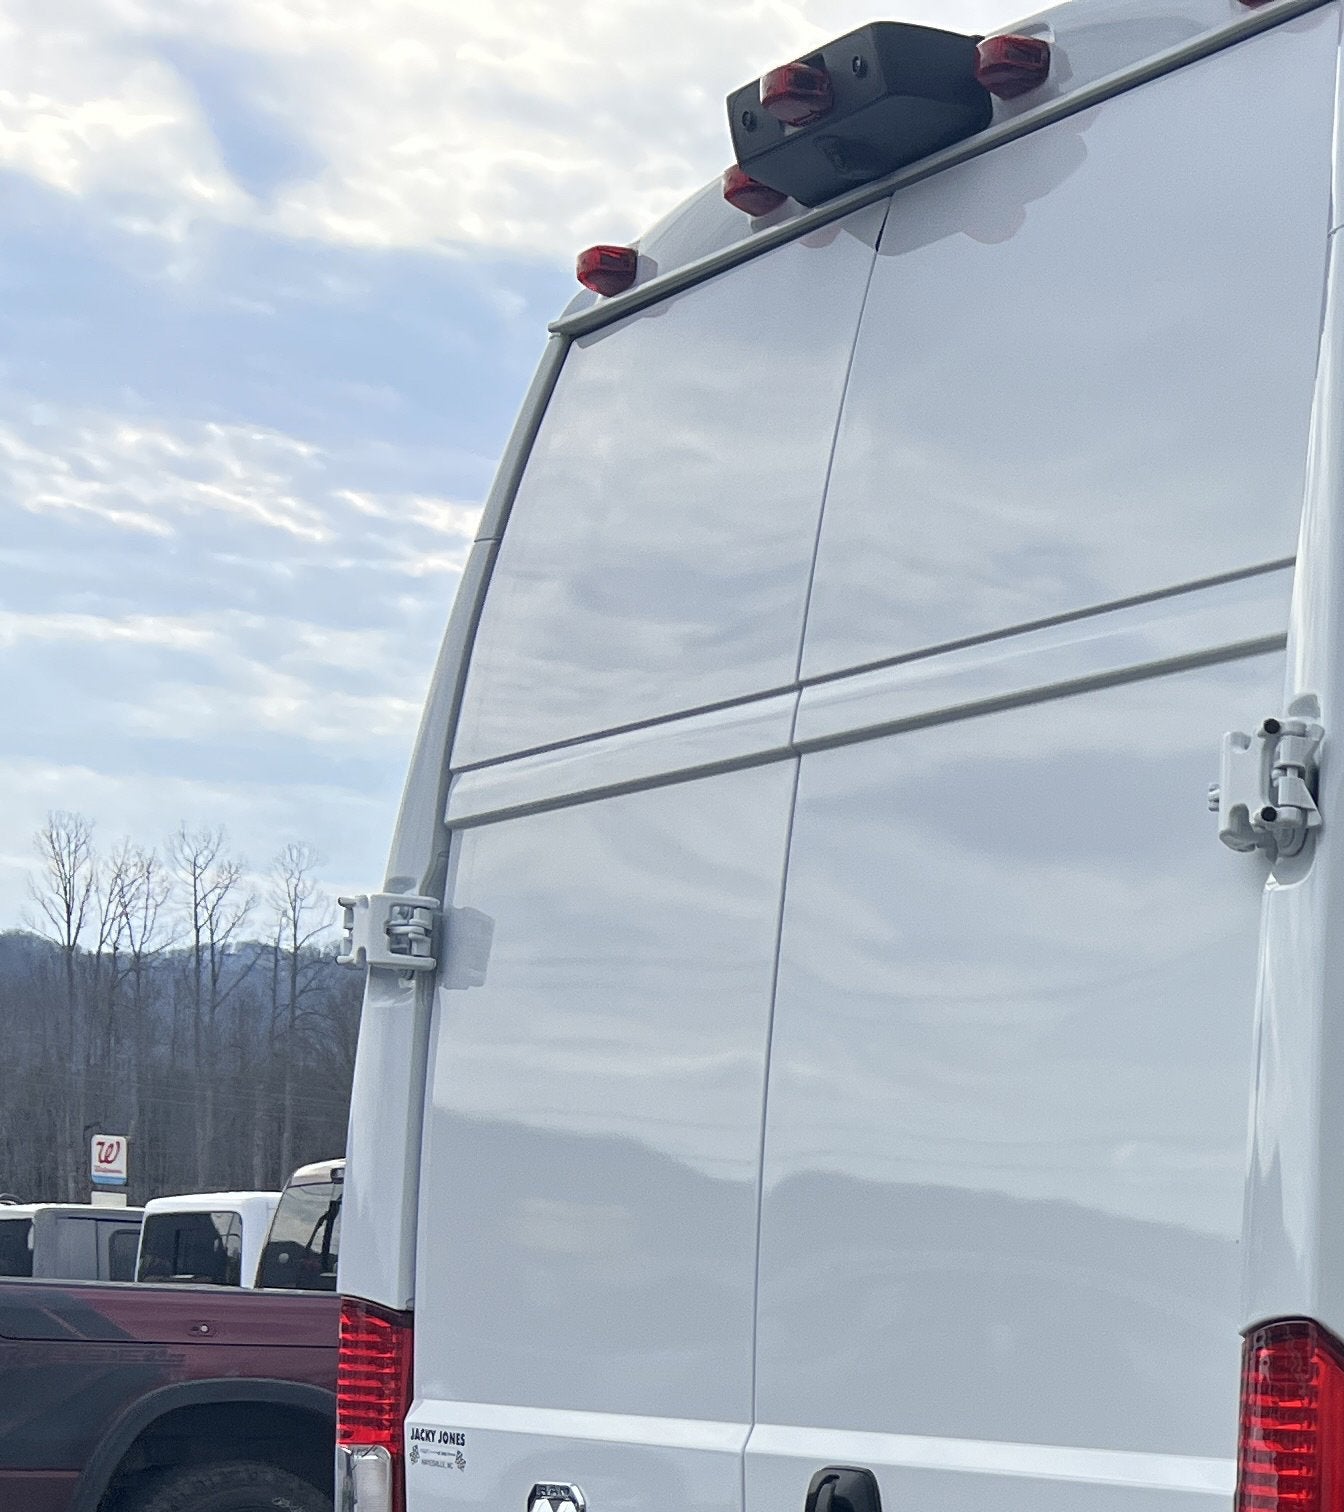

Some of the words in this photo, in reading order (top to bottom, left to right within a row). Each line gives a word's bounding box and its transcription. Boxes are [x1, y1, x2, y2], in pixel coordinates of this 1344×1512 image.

[96, 1141, 120, 1164] W
[410, 1427, 437, 1442] JACKY
[438, 1430, 465, 1447] JONES
